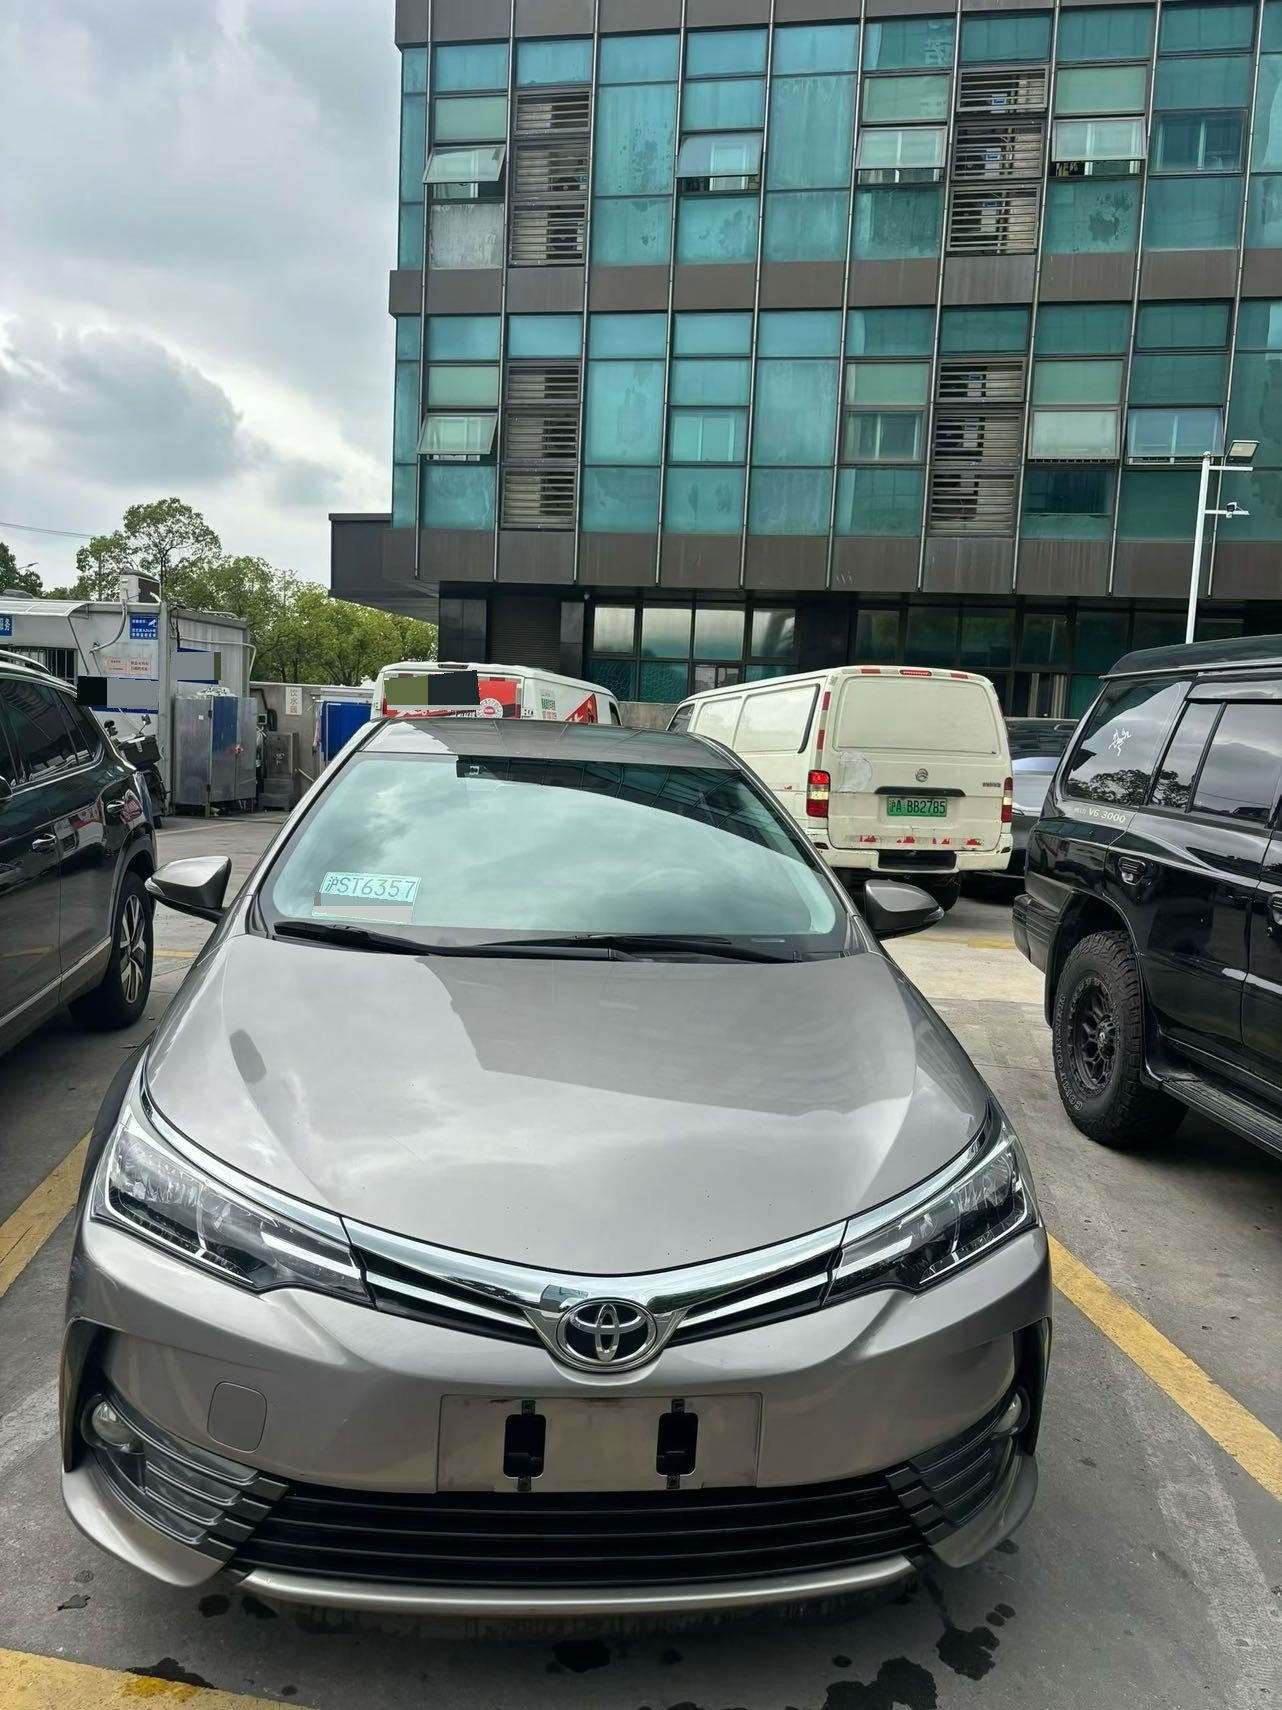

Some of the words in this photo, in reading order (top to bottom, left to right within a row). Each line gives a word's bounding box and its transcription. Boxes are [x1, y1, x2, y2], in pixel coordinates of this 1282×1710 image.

[1089, 808, 1100, 817] V6
[1101, 811, 1126, 823] 3000
[325, 876, 416, 899] 沪ST6357
